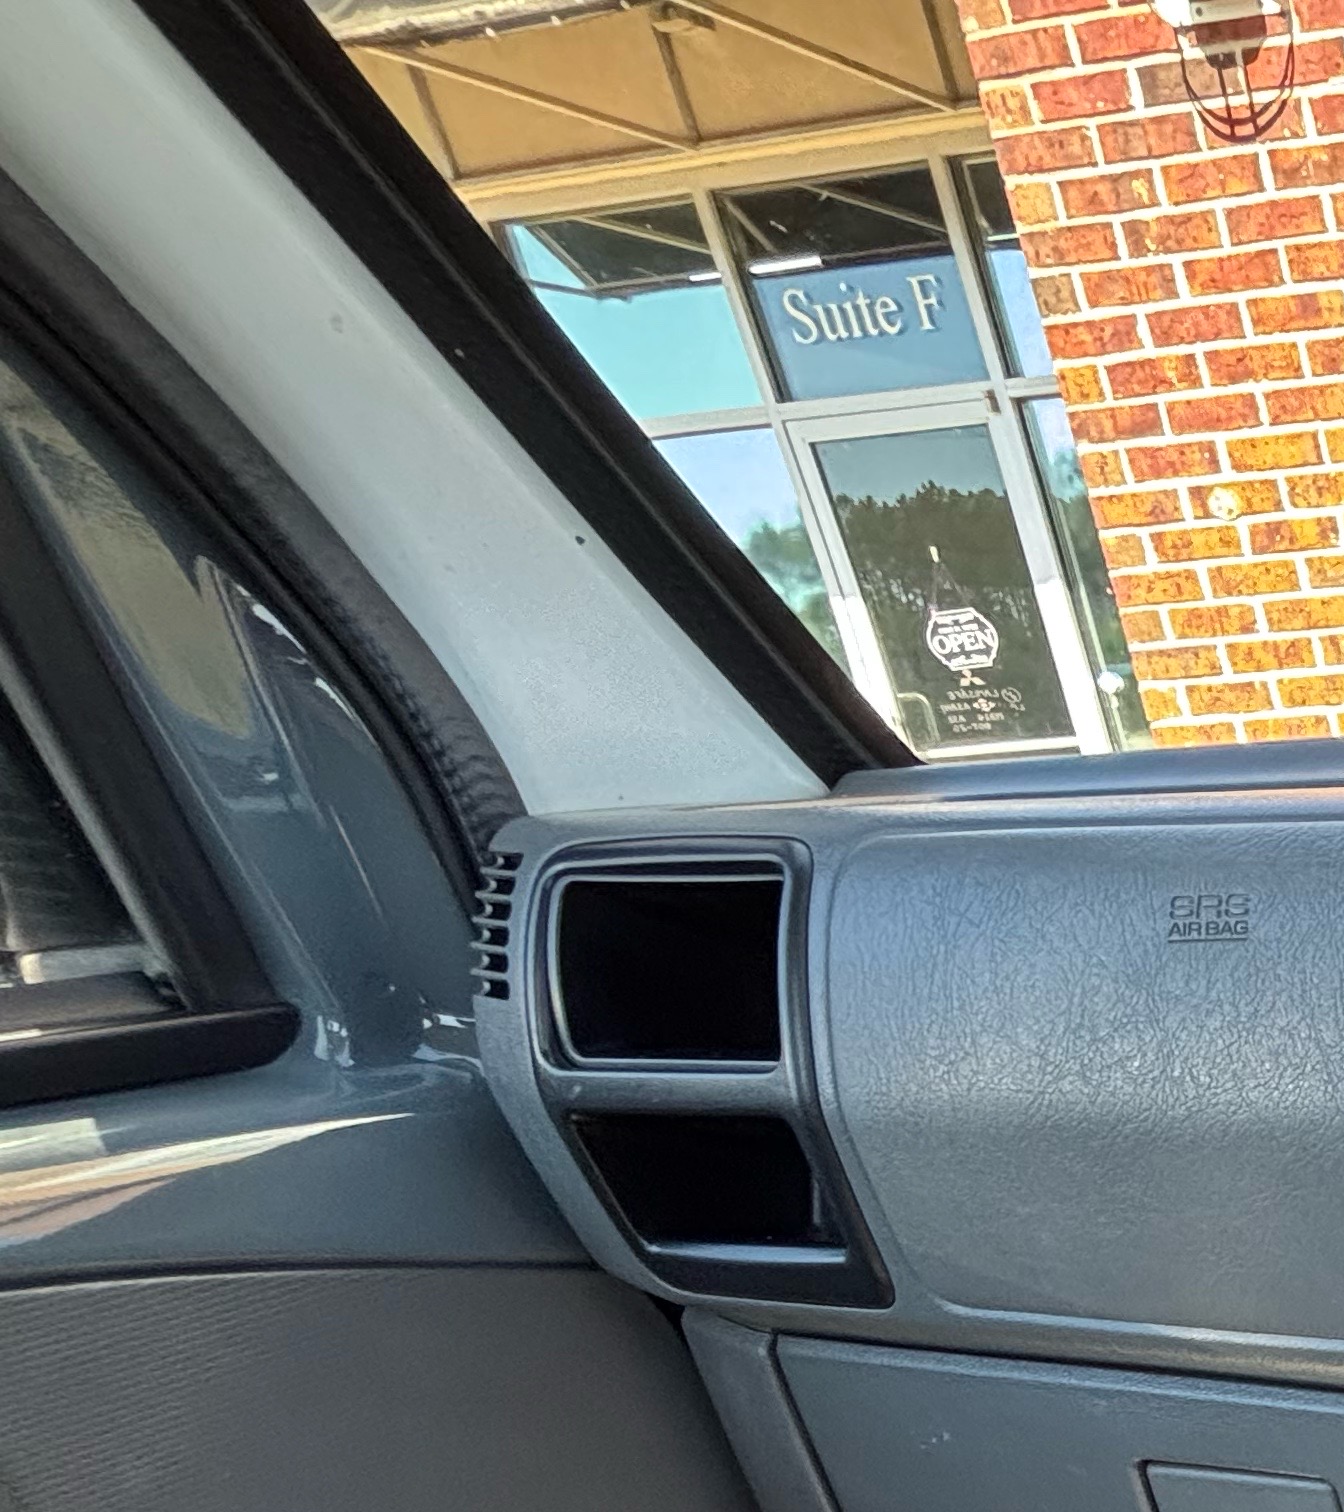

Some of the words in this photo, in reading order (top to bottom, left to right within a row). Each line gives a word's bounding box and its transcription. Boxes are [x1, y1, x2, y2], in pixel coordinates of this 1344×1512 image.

[783, 281, 903, 345] Suite
[906, 273, 941, 331] F
[932, 628, 995, 655] OPEN
[1168, 893, 1251, 920] SRS
[1167, 921, 1202, 938] AIR
[1205, 920, 1249, 937] BAG
